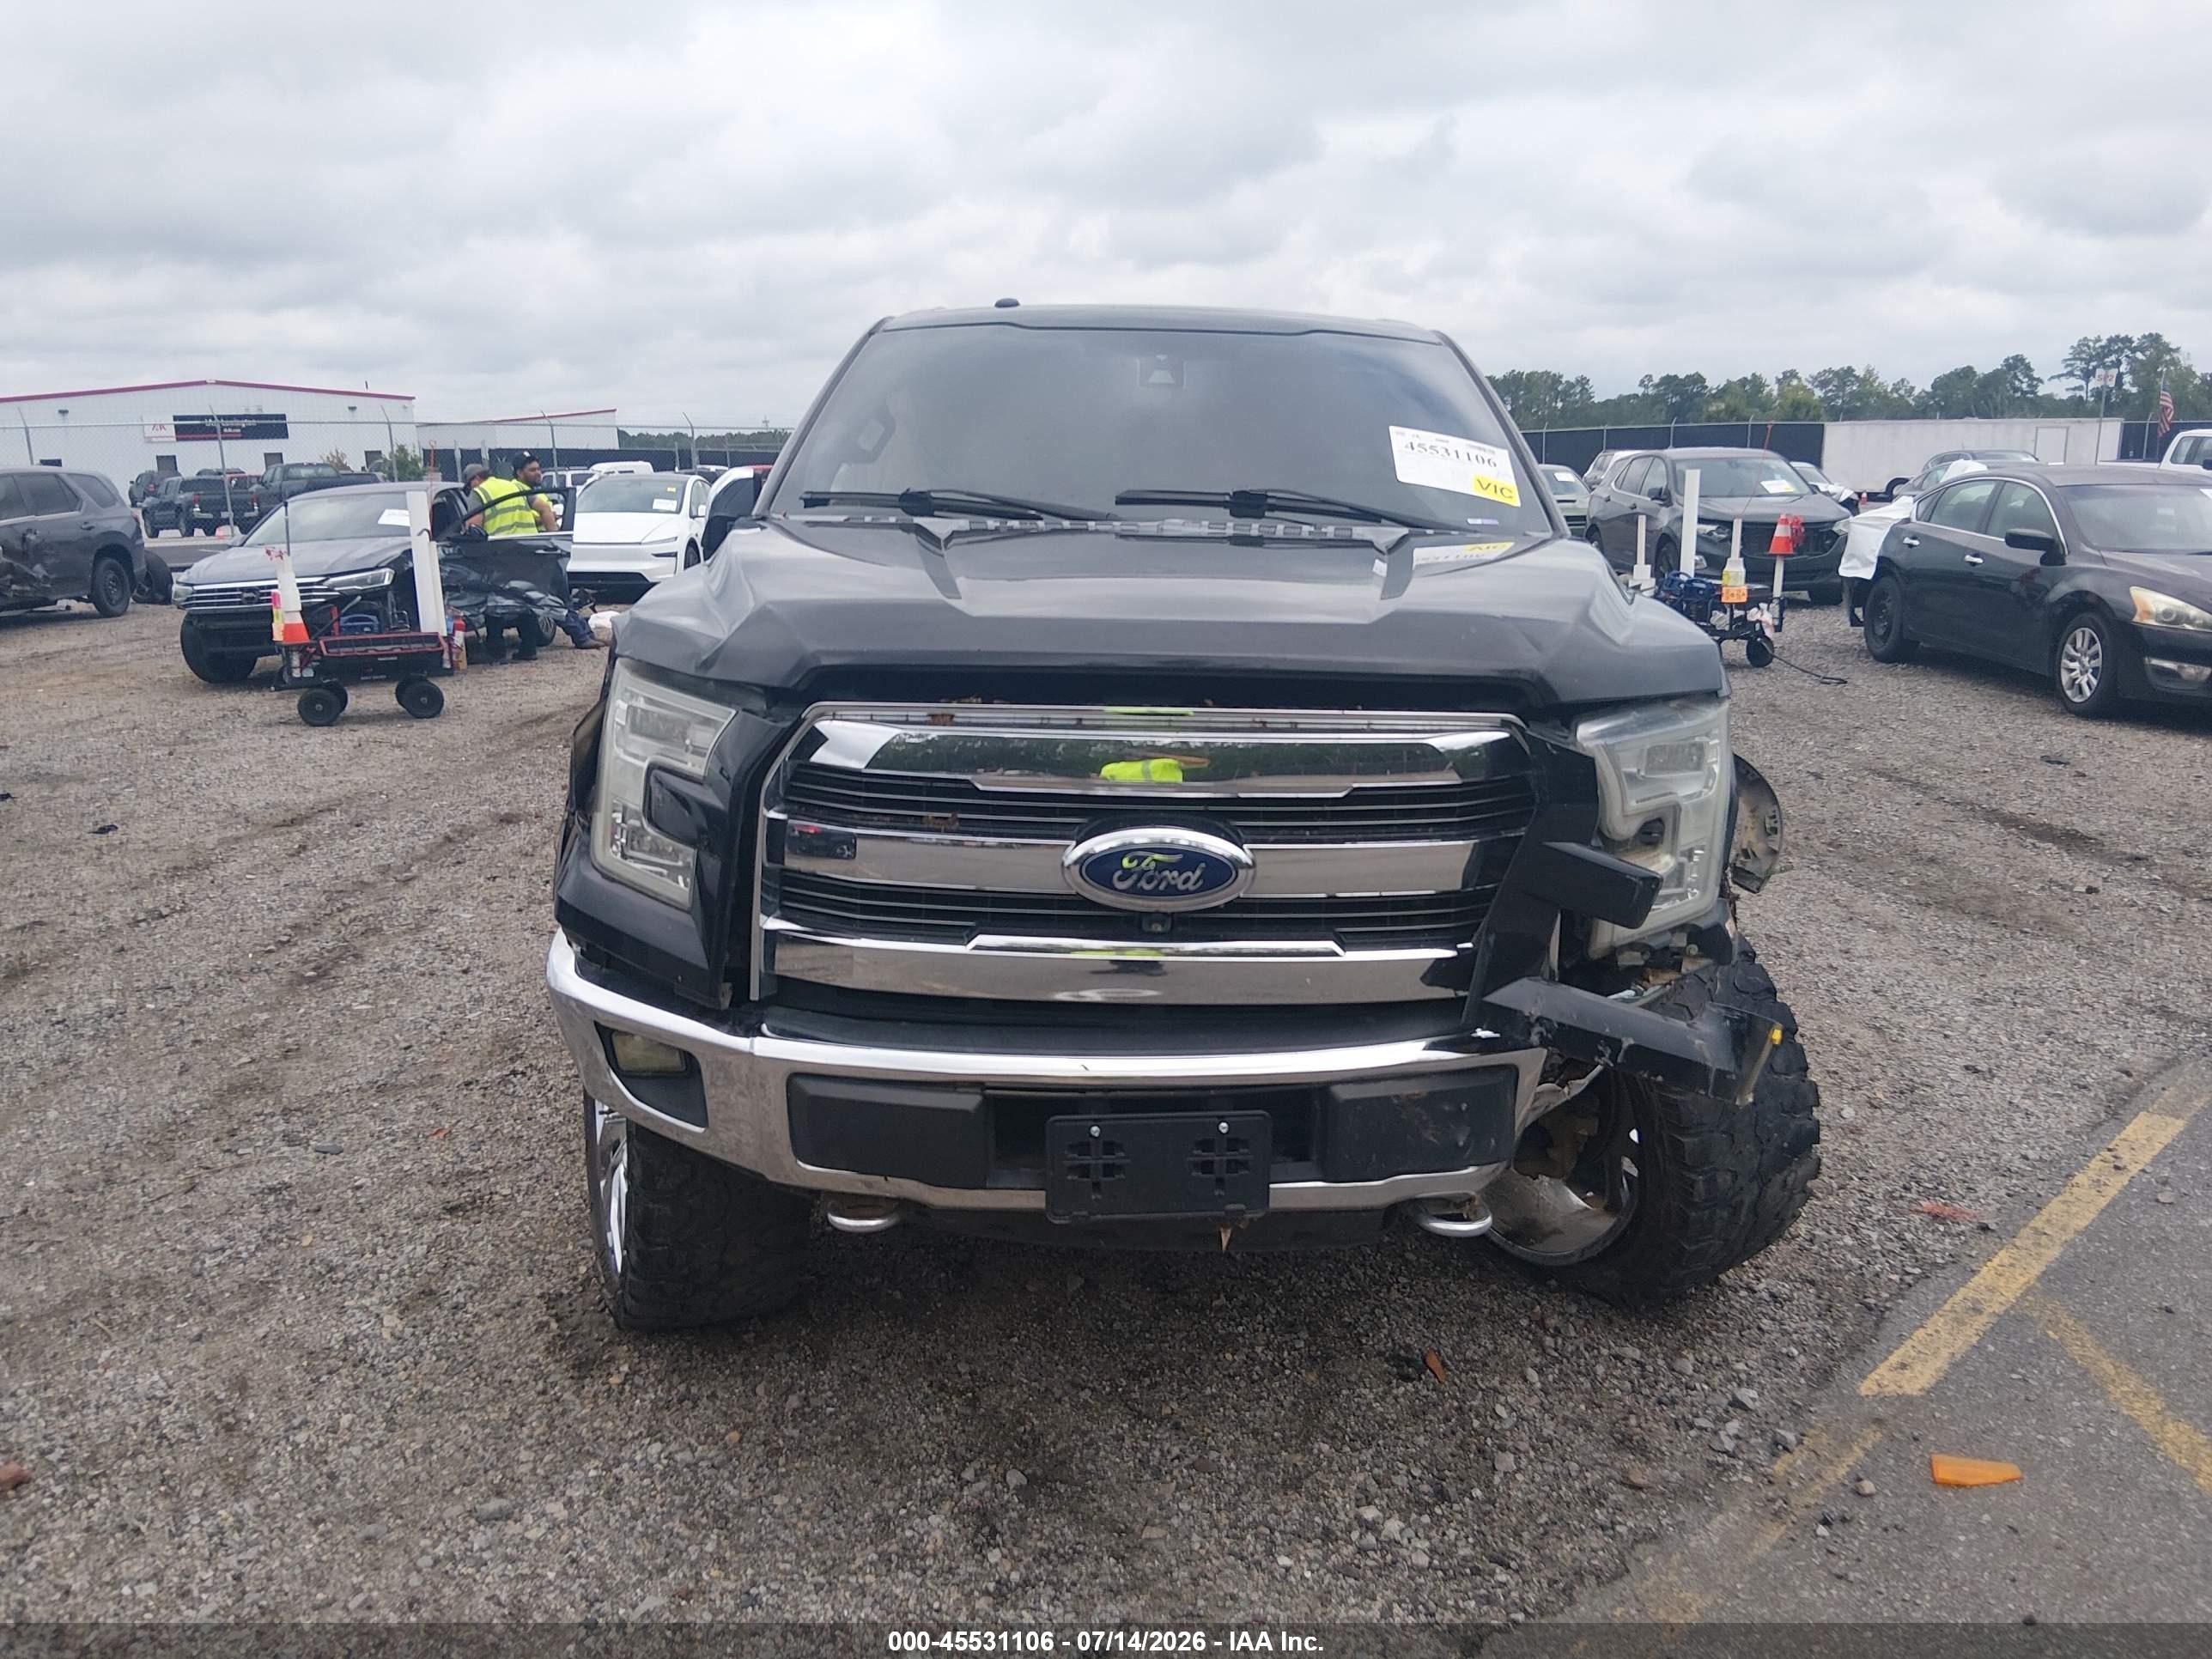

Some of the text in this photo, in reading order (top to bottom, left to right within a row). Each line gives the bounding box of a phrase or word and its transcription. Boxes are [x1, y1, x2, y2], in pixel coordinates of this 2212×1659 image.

[1404, 441, 1498, 468] 45531106
[1476, 477, 1514, 499] VIC
[1112, 850, 1206, 891] Ford
